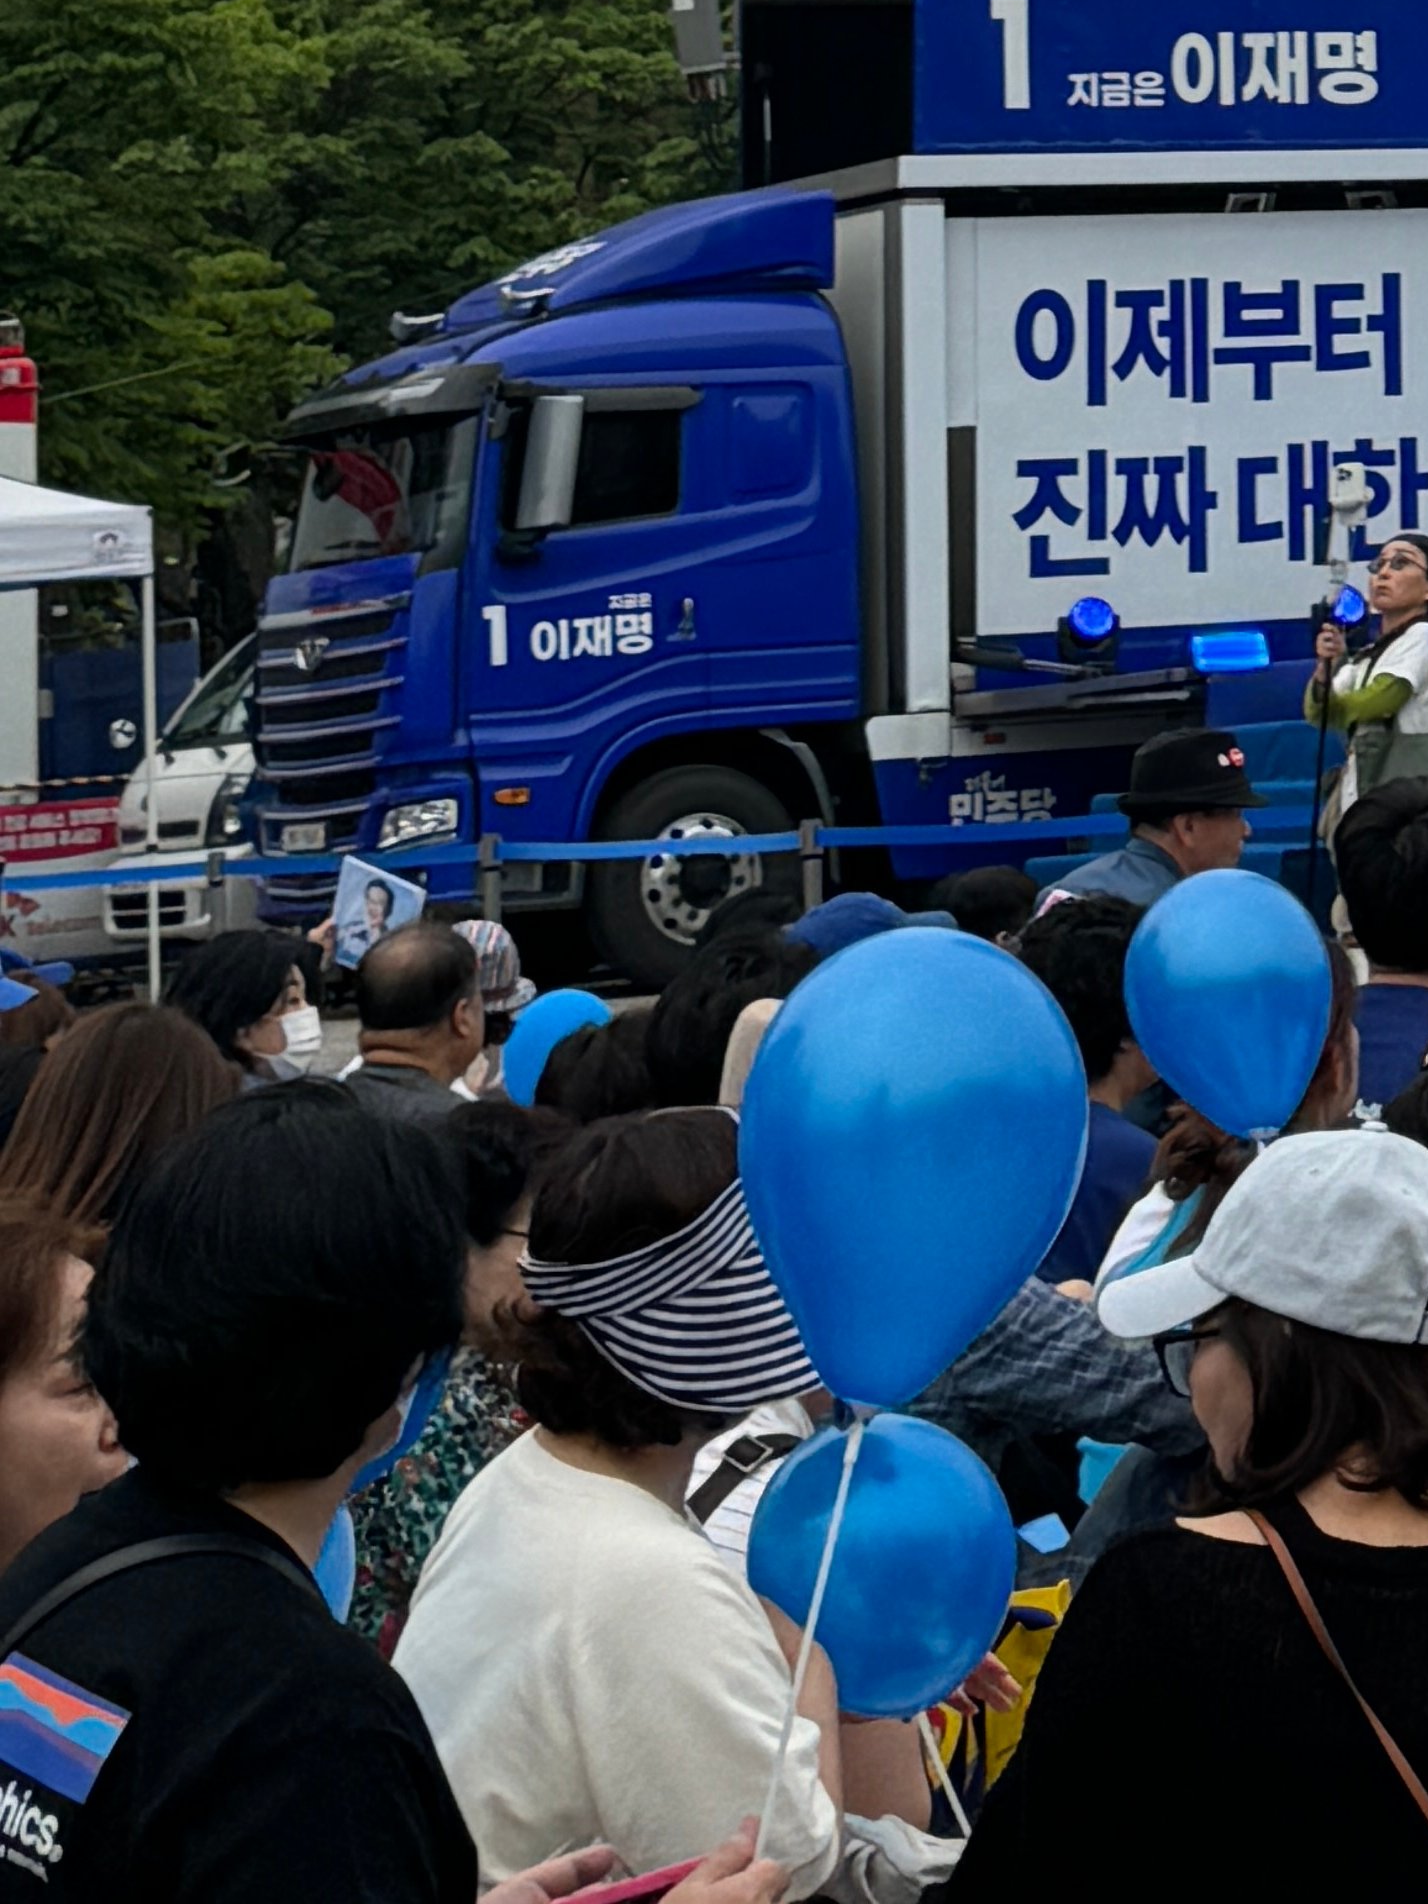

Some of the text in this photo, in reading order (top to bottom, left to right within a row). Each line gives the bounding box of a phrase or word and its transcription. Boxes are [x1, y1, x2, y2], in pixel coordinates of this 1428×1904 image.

[1066, 29, 1379, 109] 지금은 이재명
[1014, 272, 1403, 407] 이제부터
[1011, 444, 1218, 578] 진짜
[481, 604, 508, 666] 1
[530, 612, 654, 661] 이재명
